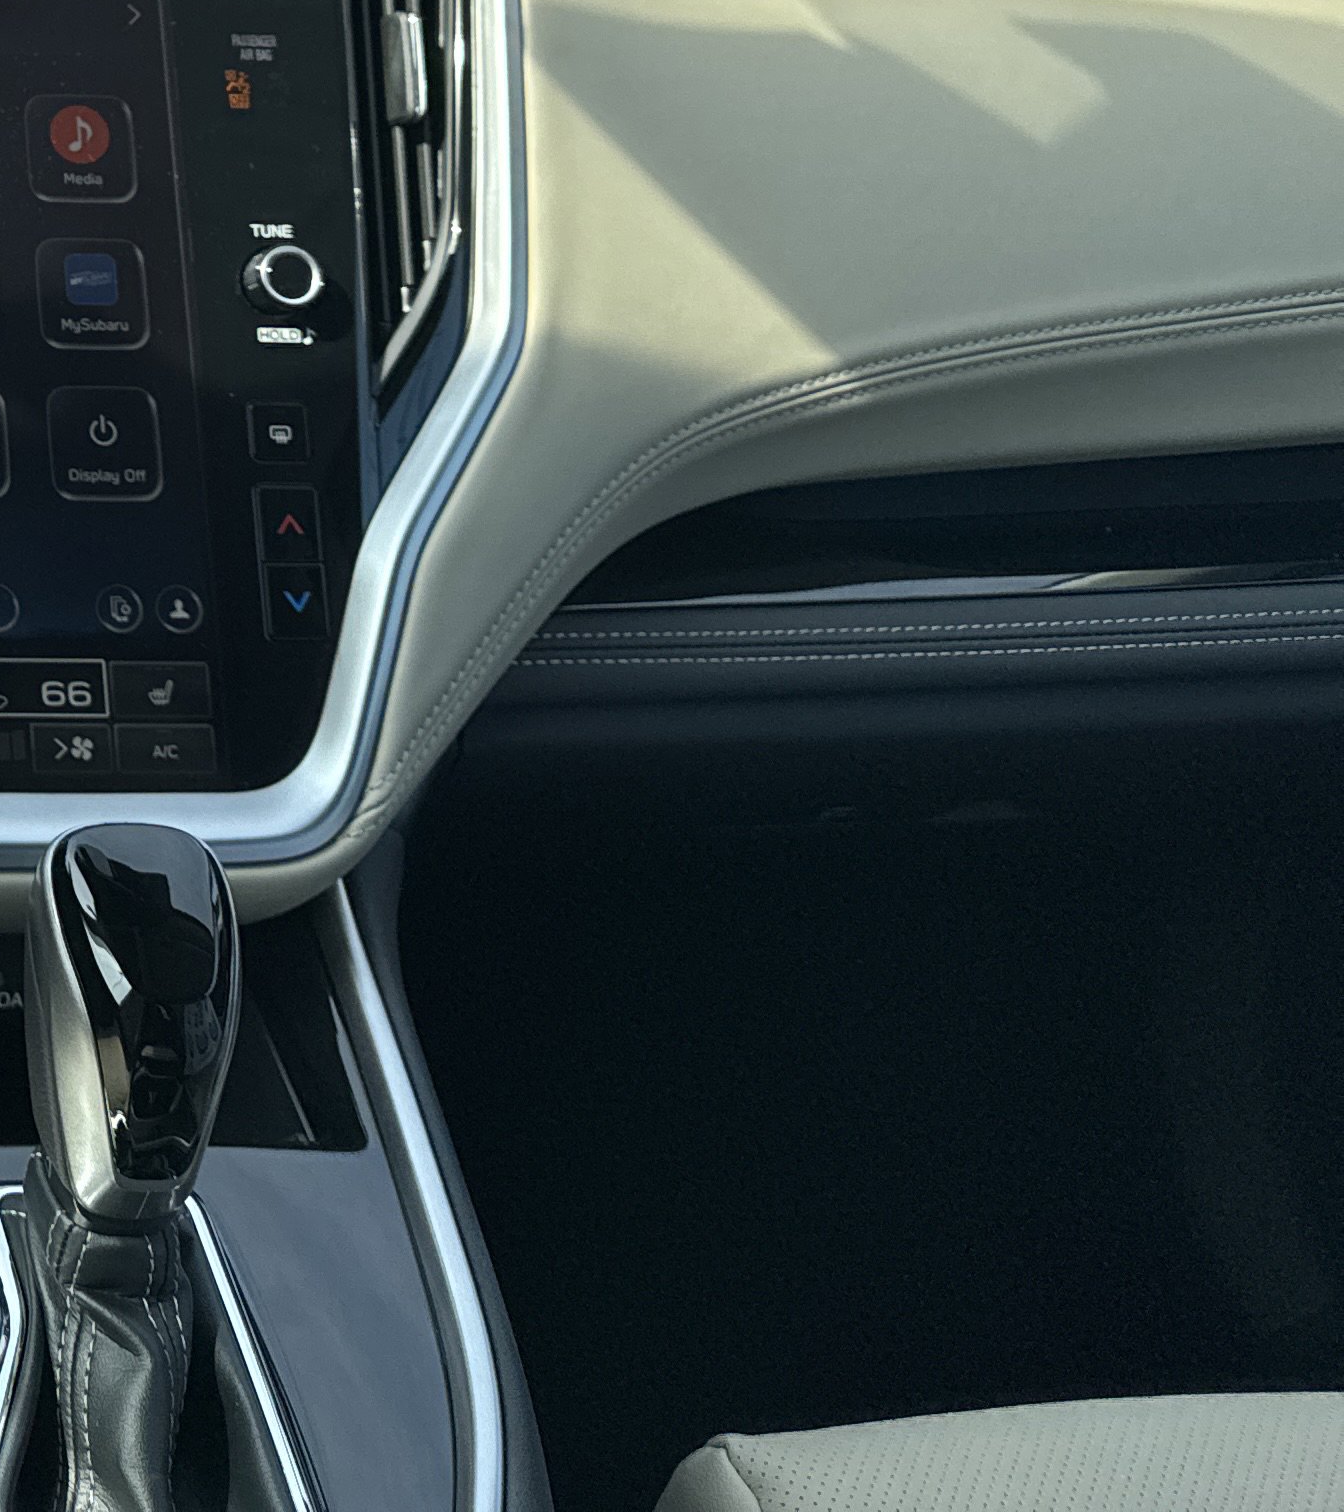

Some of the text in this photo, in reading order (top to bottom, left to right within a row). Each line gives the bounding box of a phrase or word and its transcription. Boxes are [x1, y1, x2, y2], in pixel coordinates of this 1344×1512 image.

[63, 172, 103, 187] Media
[249, 223, 294, 239] TUNE
[60, 317, 130, 334] MySubaru
[257, 328, 301, 343] HOLD
[68, 467, 147, 486] Display Off
[40, 680, 92, 708] 66
[152, 743, 179, 761] A/C
